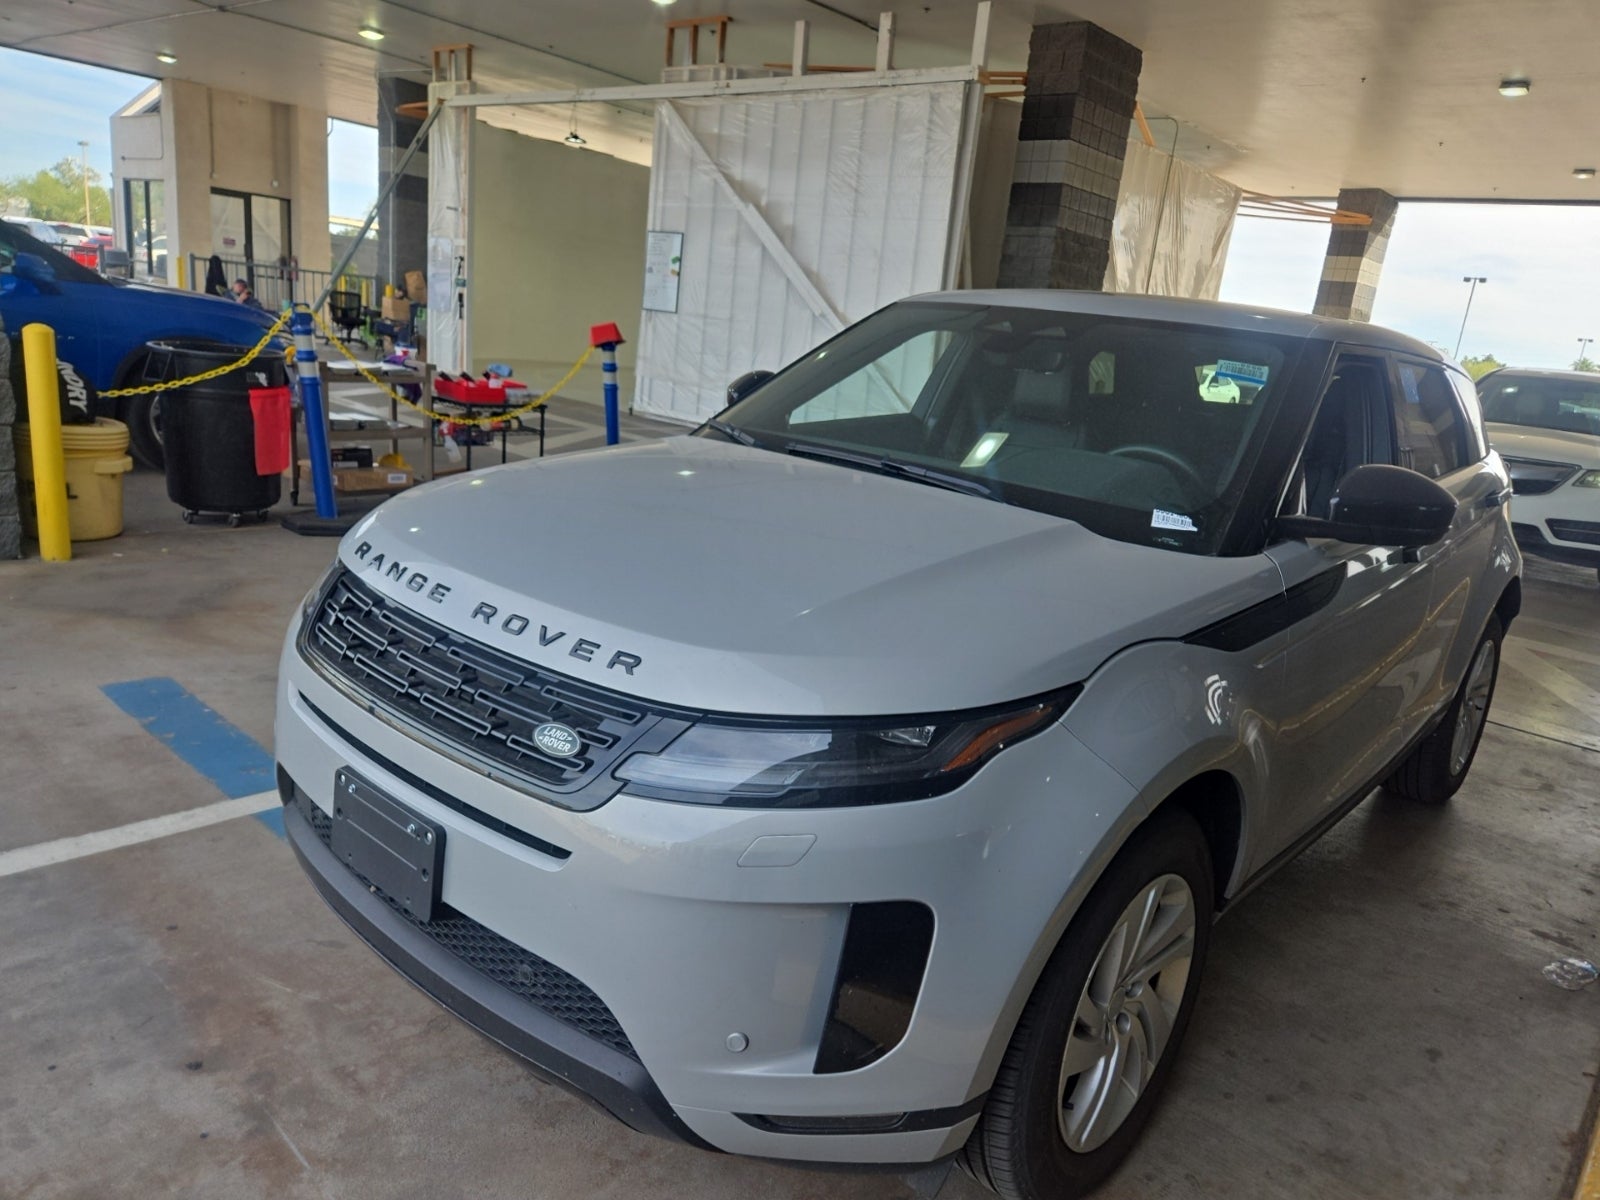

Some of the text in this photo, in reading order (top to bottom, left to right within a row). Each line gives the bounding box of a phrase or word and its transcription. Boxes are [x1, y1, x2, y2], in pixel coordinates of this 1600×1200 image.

[354, 541, 642, 676] RANGE ROVER
[543, 727, 569, 741] LAND
[541, 735, 571, 752] ROVER
